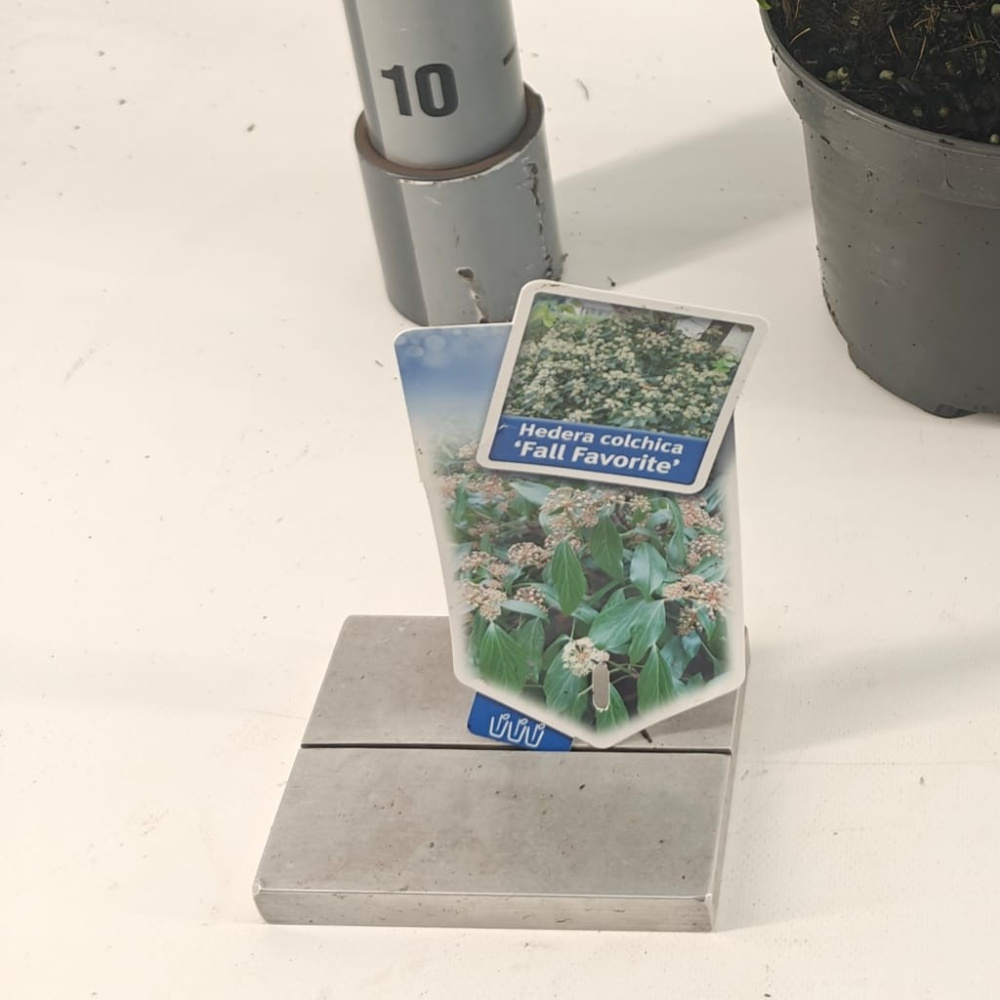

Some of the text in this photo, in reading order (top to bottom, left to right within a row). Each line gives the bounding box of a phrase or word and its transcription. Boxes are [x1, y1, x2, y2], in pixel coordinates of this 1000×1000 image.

[380, 63, 459, 118] 10
[519, 423, 684, 455] Hedera colchica
